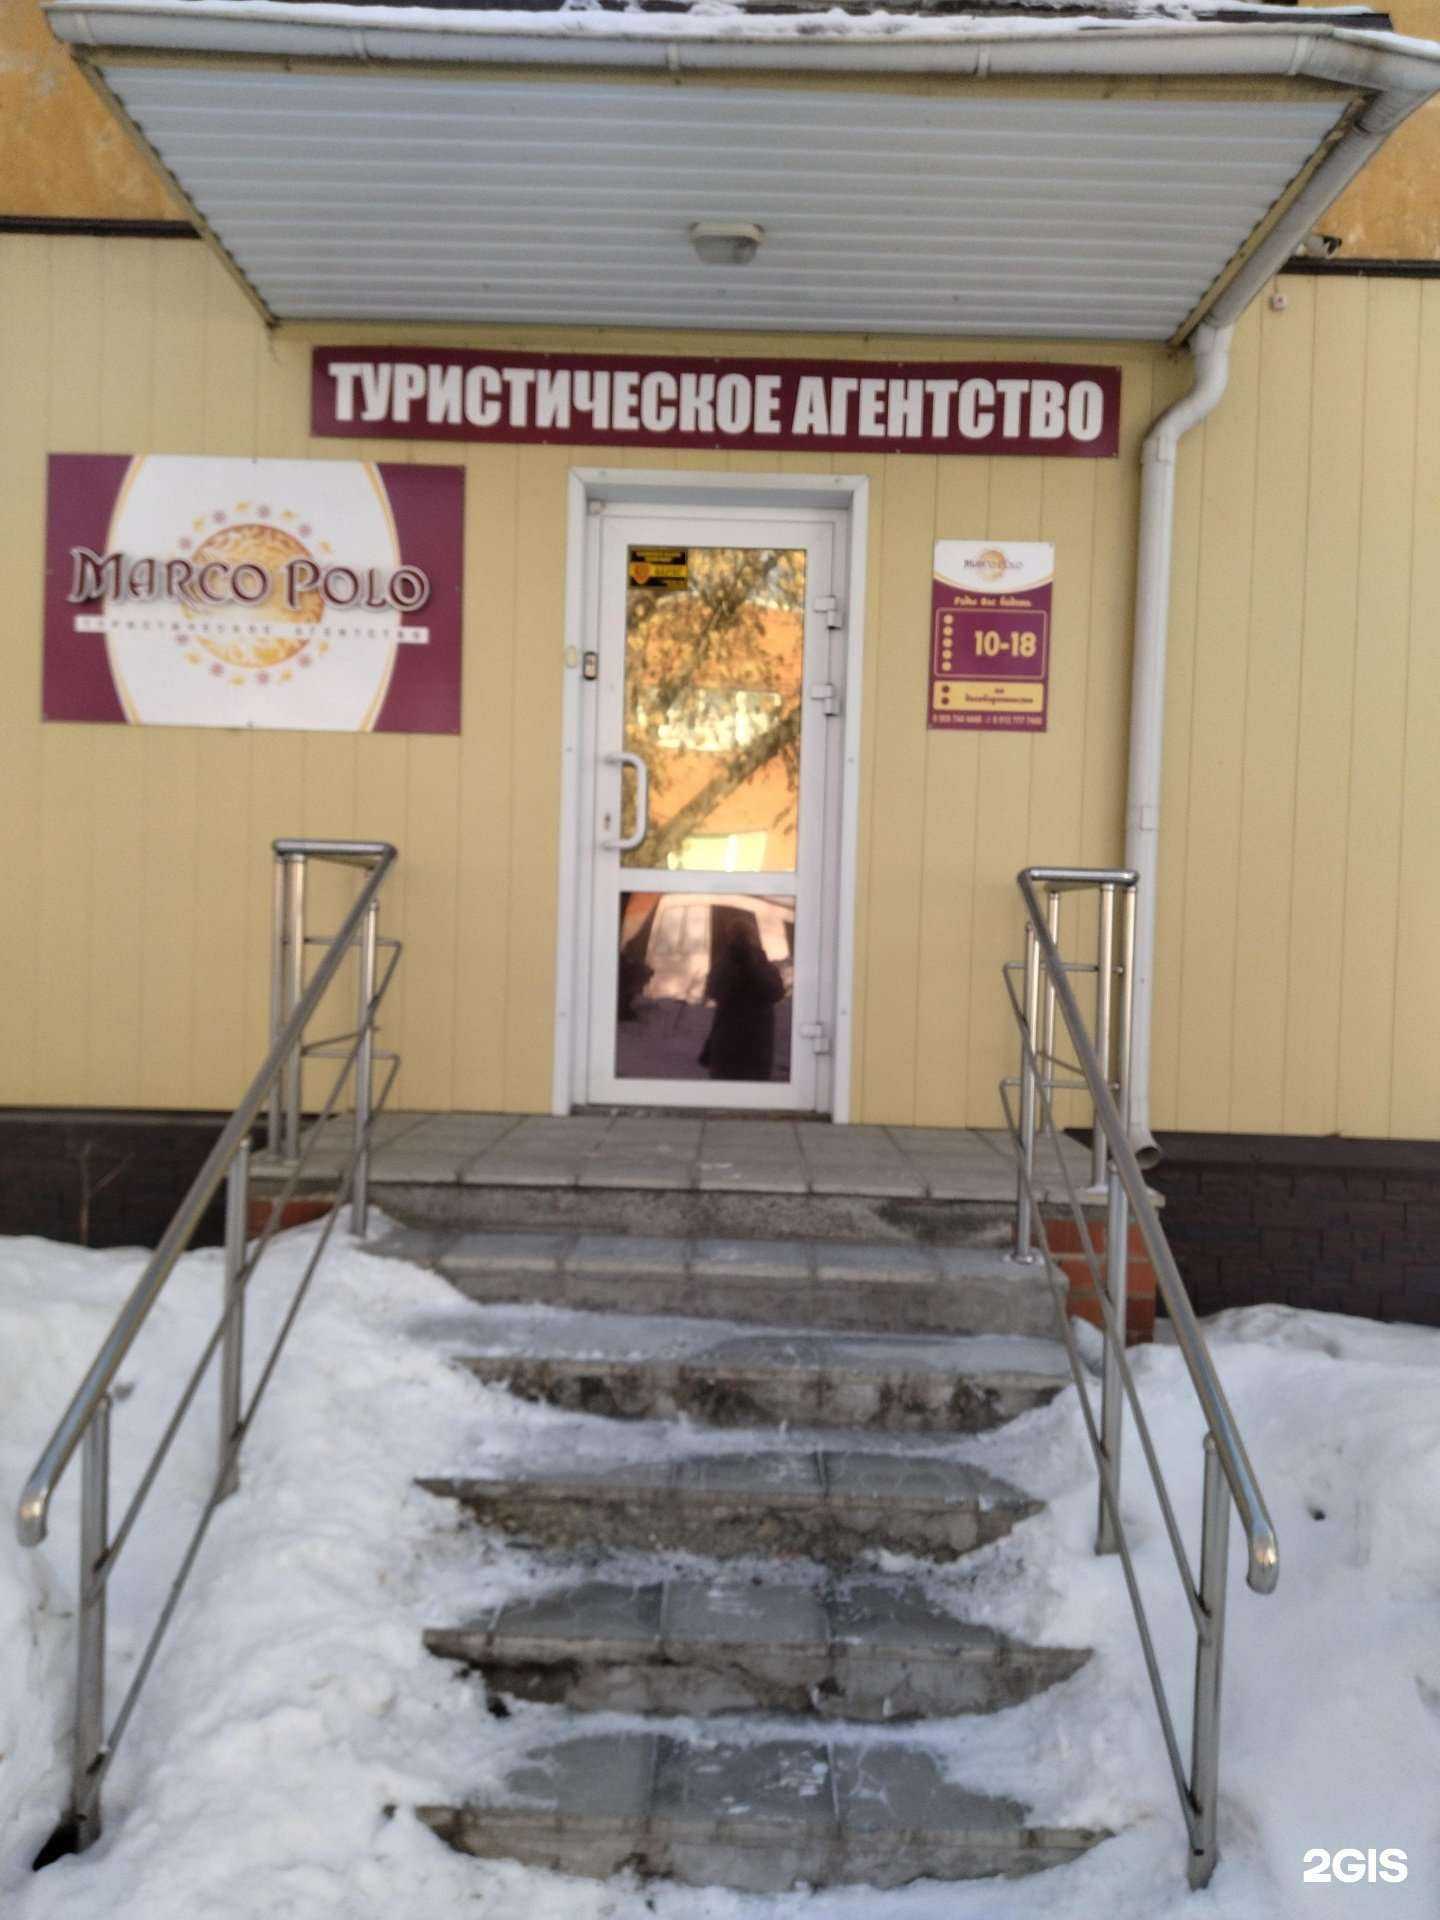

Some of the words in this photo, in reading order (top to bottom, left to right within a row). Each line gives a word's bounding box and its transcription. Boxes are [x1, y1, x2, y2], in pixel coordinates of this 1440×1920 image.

[328, 362, 782, 434] ТУРИСТИЧЕСКОЕ
[792, 375, 1104, 442] АГЕНТСТВО
[69, 546, 269, 612] MARCO
[286, 558, 430, 613] POLO
[974, 630, 1037, 658] 10-18
